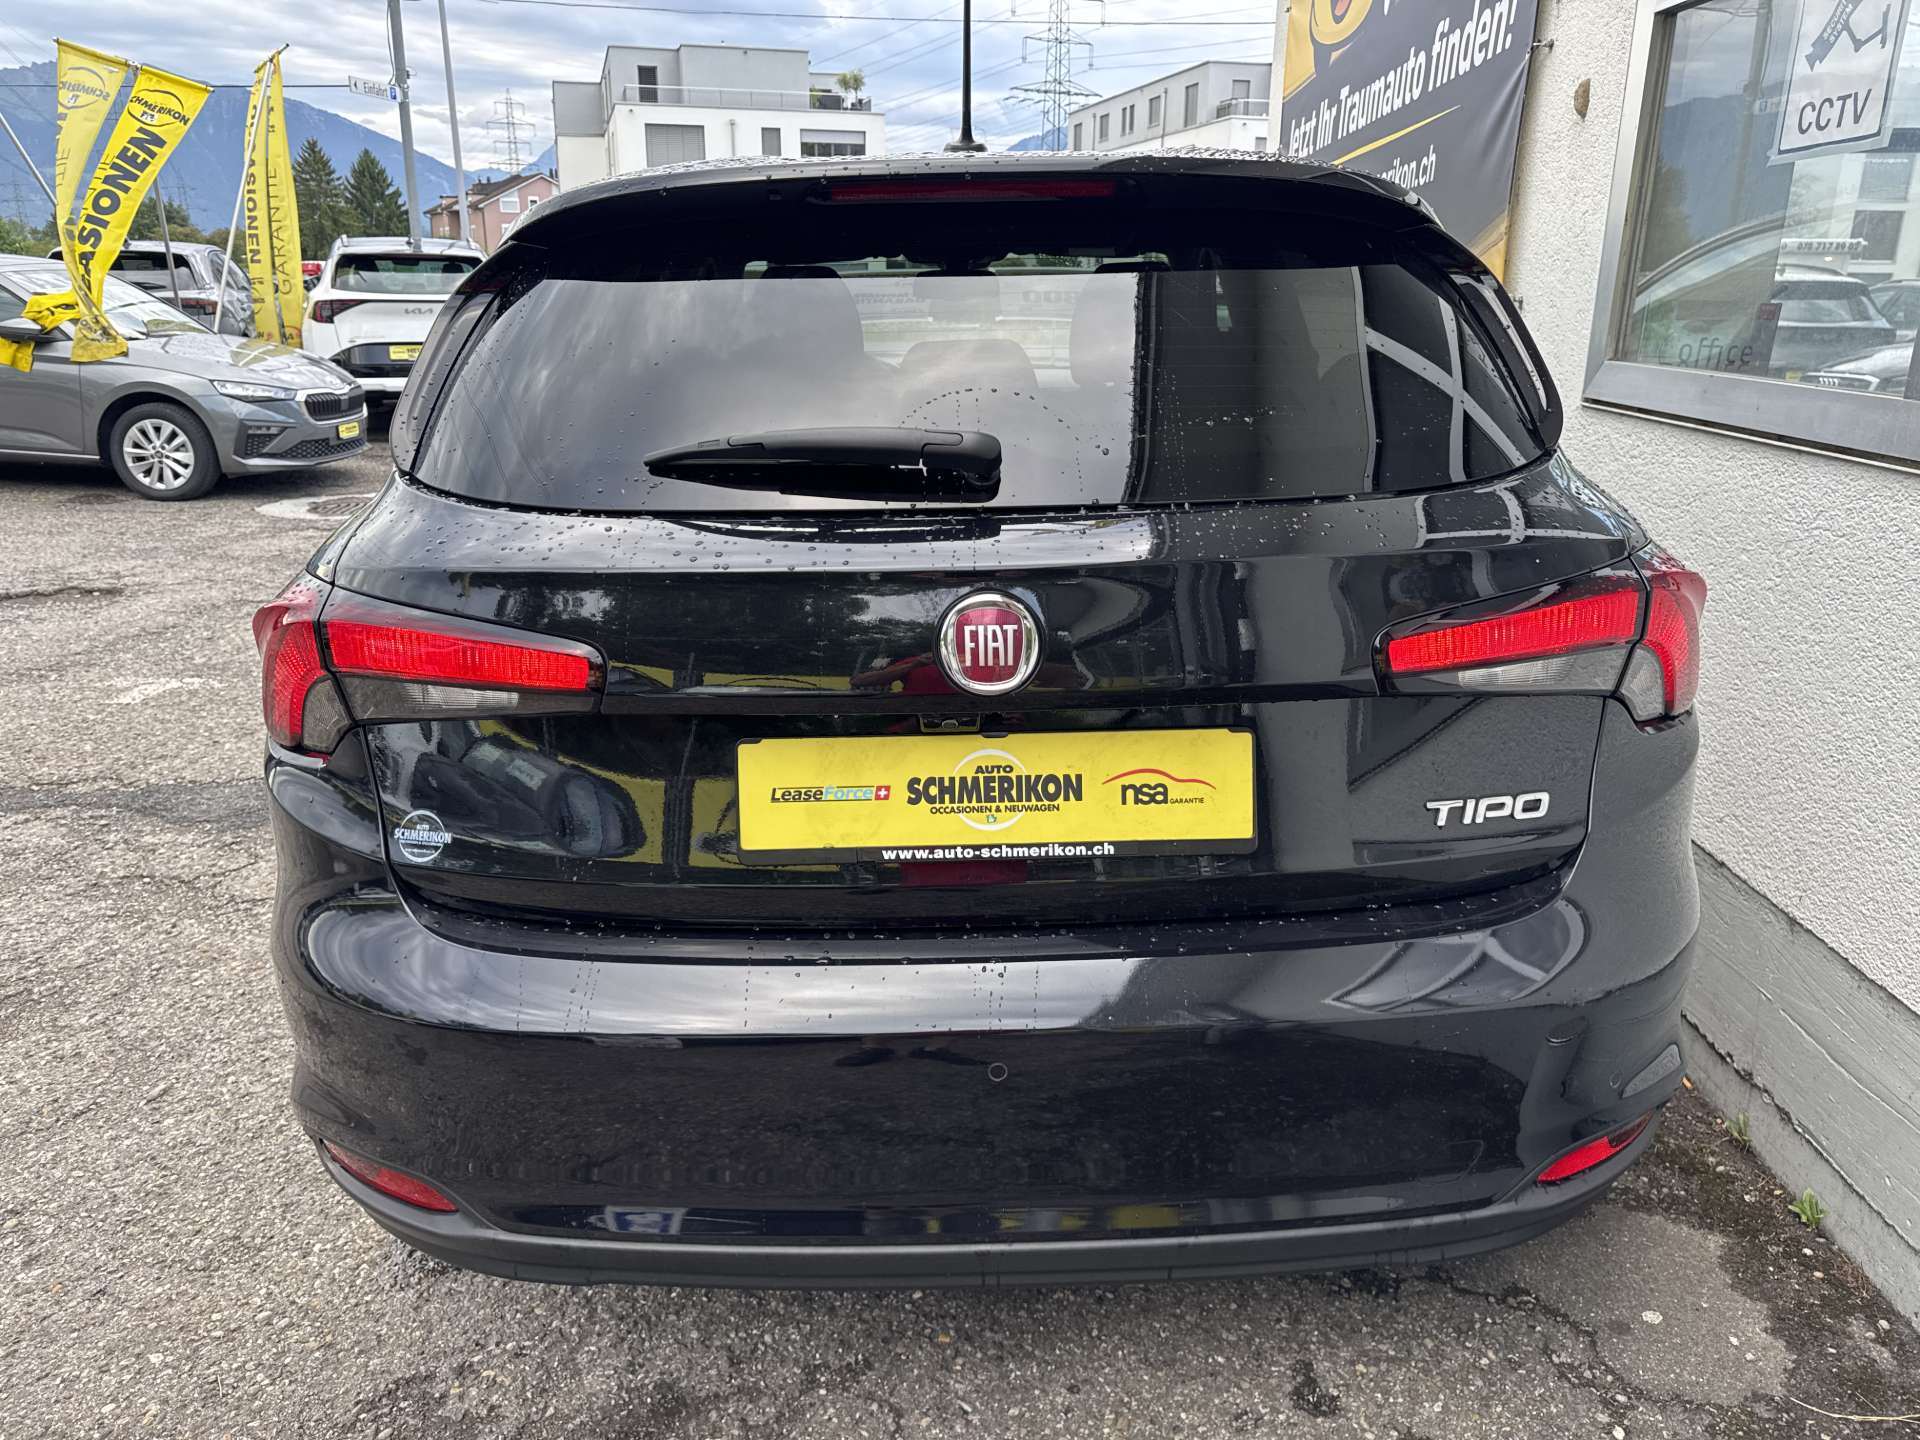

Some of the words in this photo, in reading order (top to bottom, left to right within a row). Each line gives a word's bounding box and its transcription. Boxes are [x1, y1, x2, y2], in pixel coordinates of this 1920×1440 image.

[1316, 99, 1338, 150] Ihr
[1338, 46, 1426, 140] Traumauto
[1428, 0, 1517, 92] finden!
[1797, 88, 1873, 135] CCTV
[964, 625, 1018, 667] FIAT
[975, 765, 1014, 775] AUTO
[771, 785, 873, 802] LeaseForce
[906, 773, 1083, 806] SCHMERIKON
[1121, 783, 1169, 805] nsa
[930, 805, 993, 815] OCCASIONEN
[995, 805, 1002, 813] &
[1004, 803, 1060, 813] NEUWAGEN
[1170, 797, 1205, 805] GARANTIE
[1426, 791, 1550, 827] TIPO
[394, 828, 452, 844] SCHMERIKON
[881, 842, 1115, 860] www.auto-schmerikon.ch
